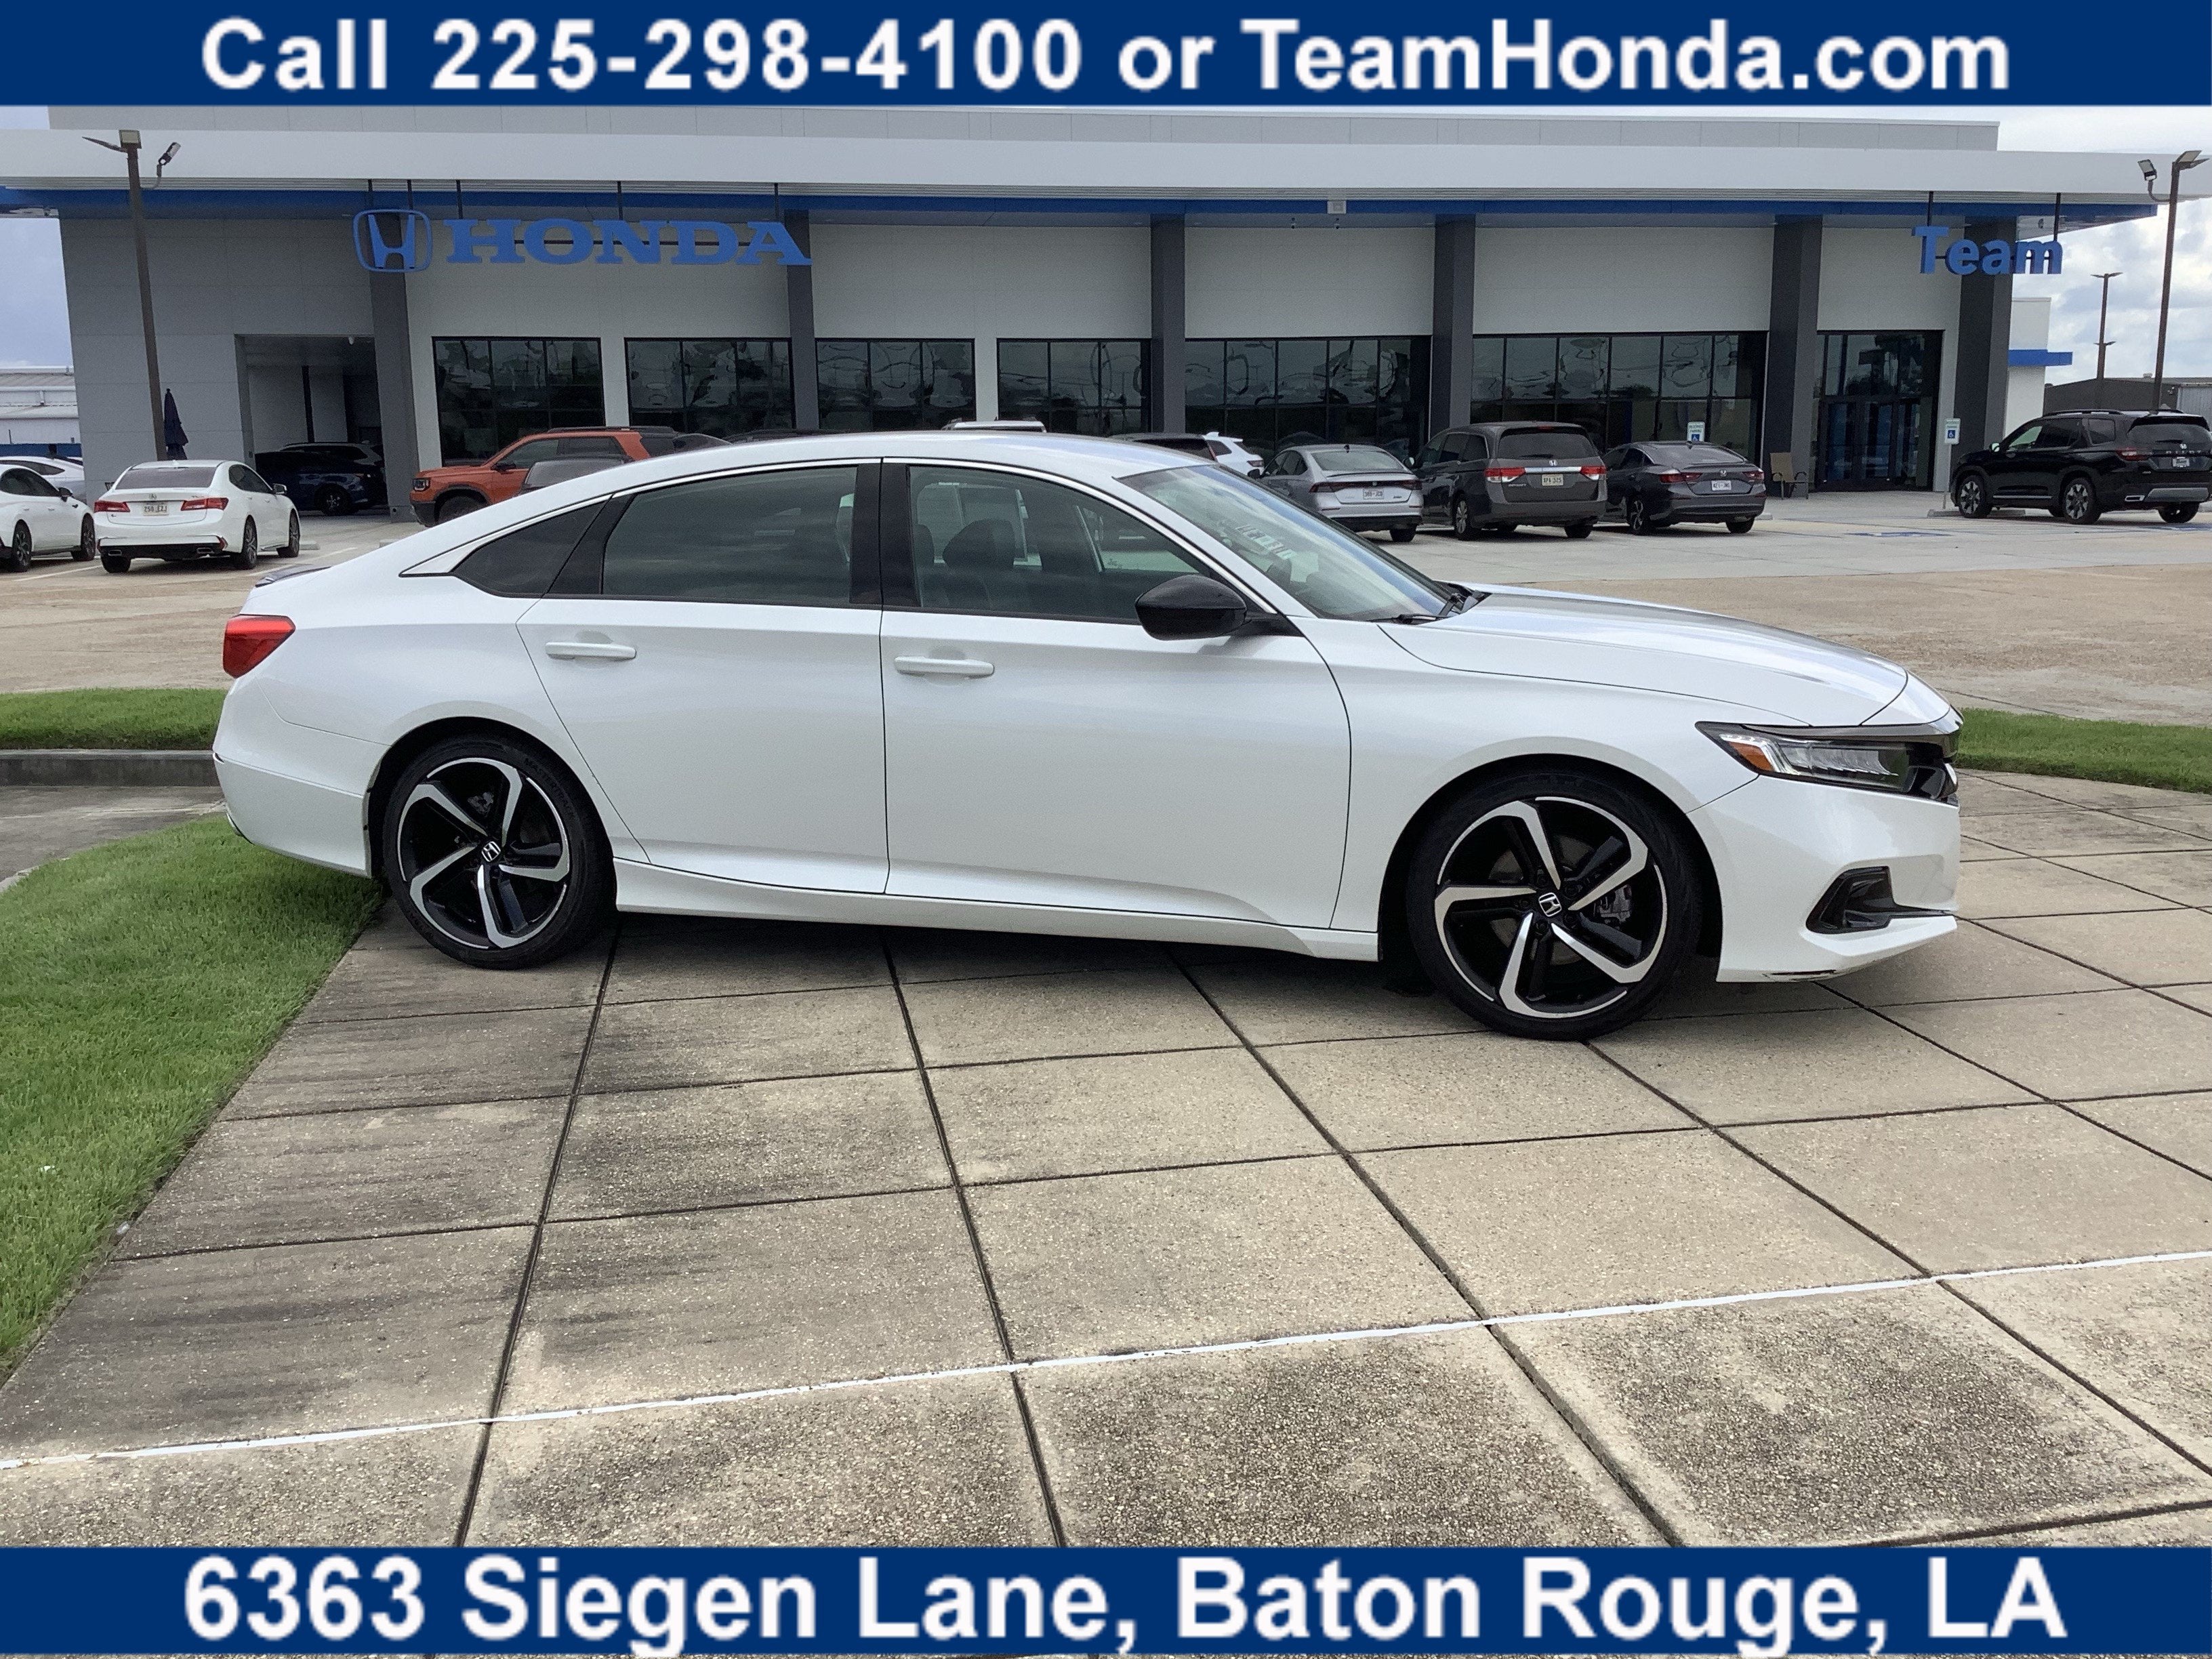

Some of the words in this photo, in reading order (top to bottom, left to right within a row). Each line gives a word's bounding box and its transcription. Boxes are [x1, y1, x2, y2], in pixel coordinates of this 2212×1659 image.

[443, 218, 812, 265] HONDA
[1912, 226, 2063, 275] Team
[524, 757, 576, 819] MASTERTRACK
